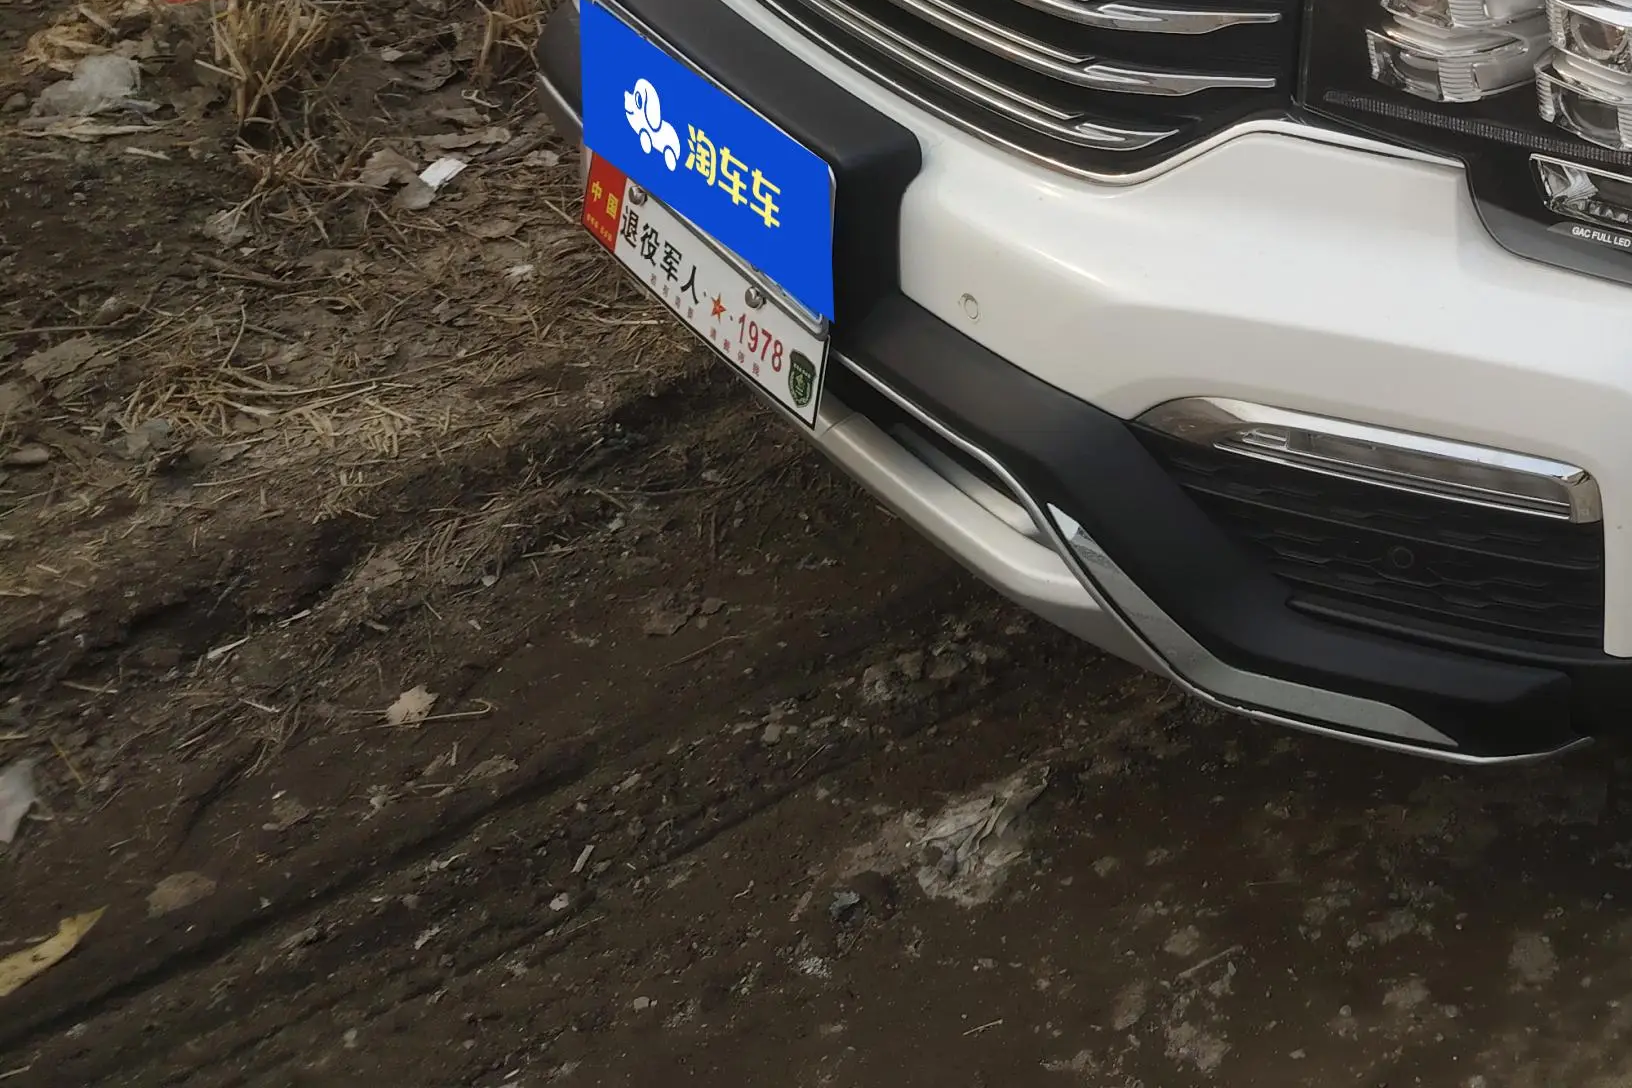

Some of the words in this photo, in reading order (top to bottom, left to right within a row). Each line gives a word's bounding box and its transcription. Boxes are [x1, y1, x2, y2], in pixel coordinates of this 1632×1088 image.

[591, 181, 619, 220] 中国
[1572, 226, 1591, 238] GAC
[1591, 231, 1612, 243] FULL
[1613, 235, 1631, 248] LED
[620, 205, 699, 304] 退役军人
[738, 314, 783, 372] 1978
